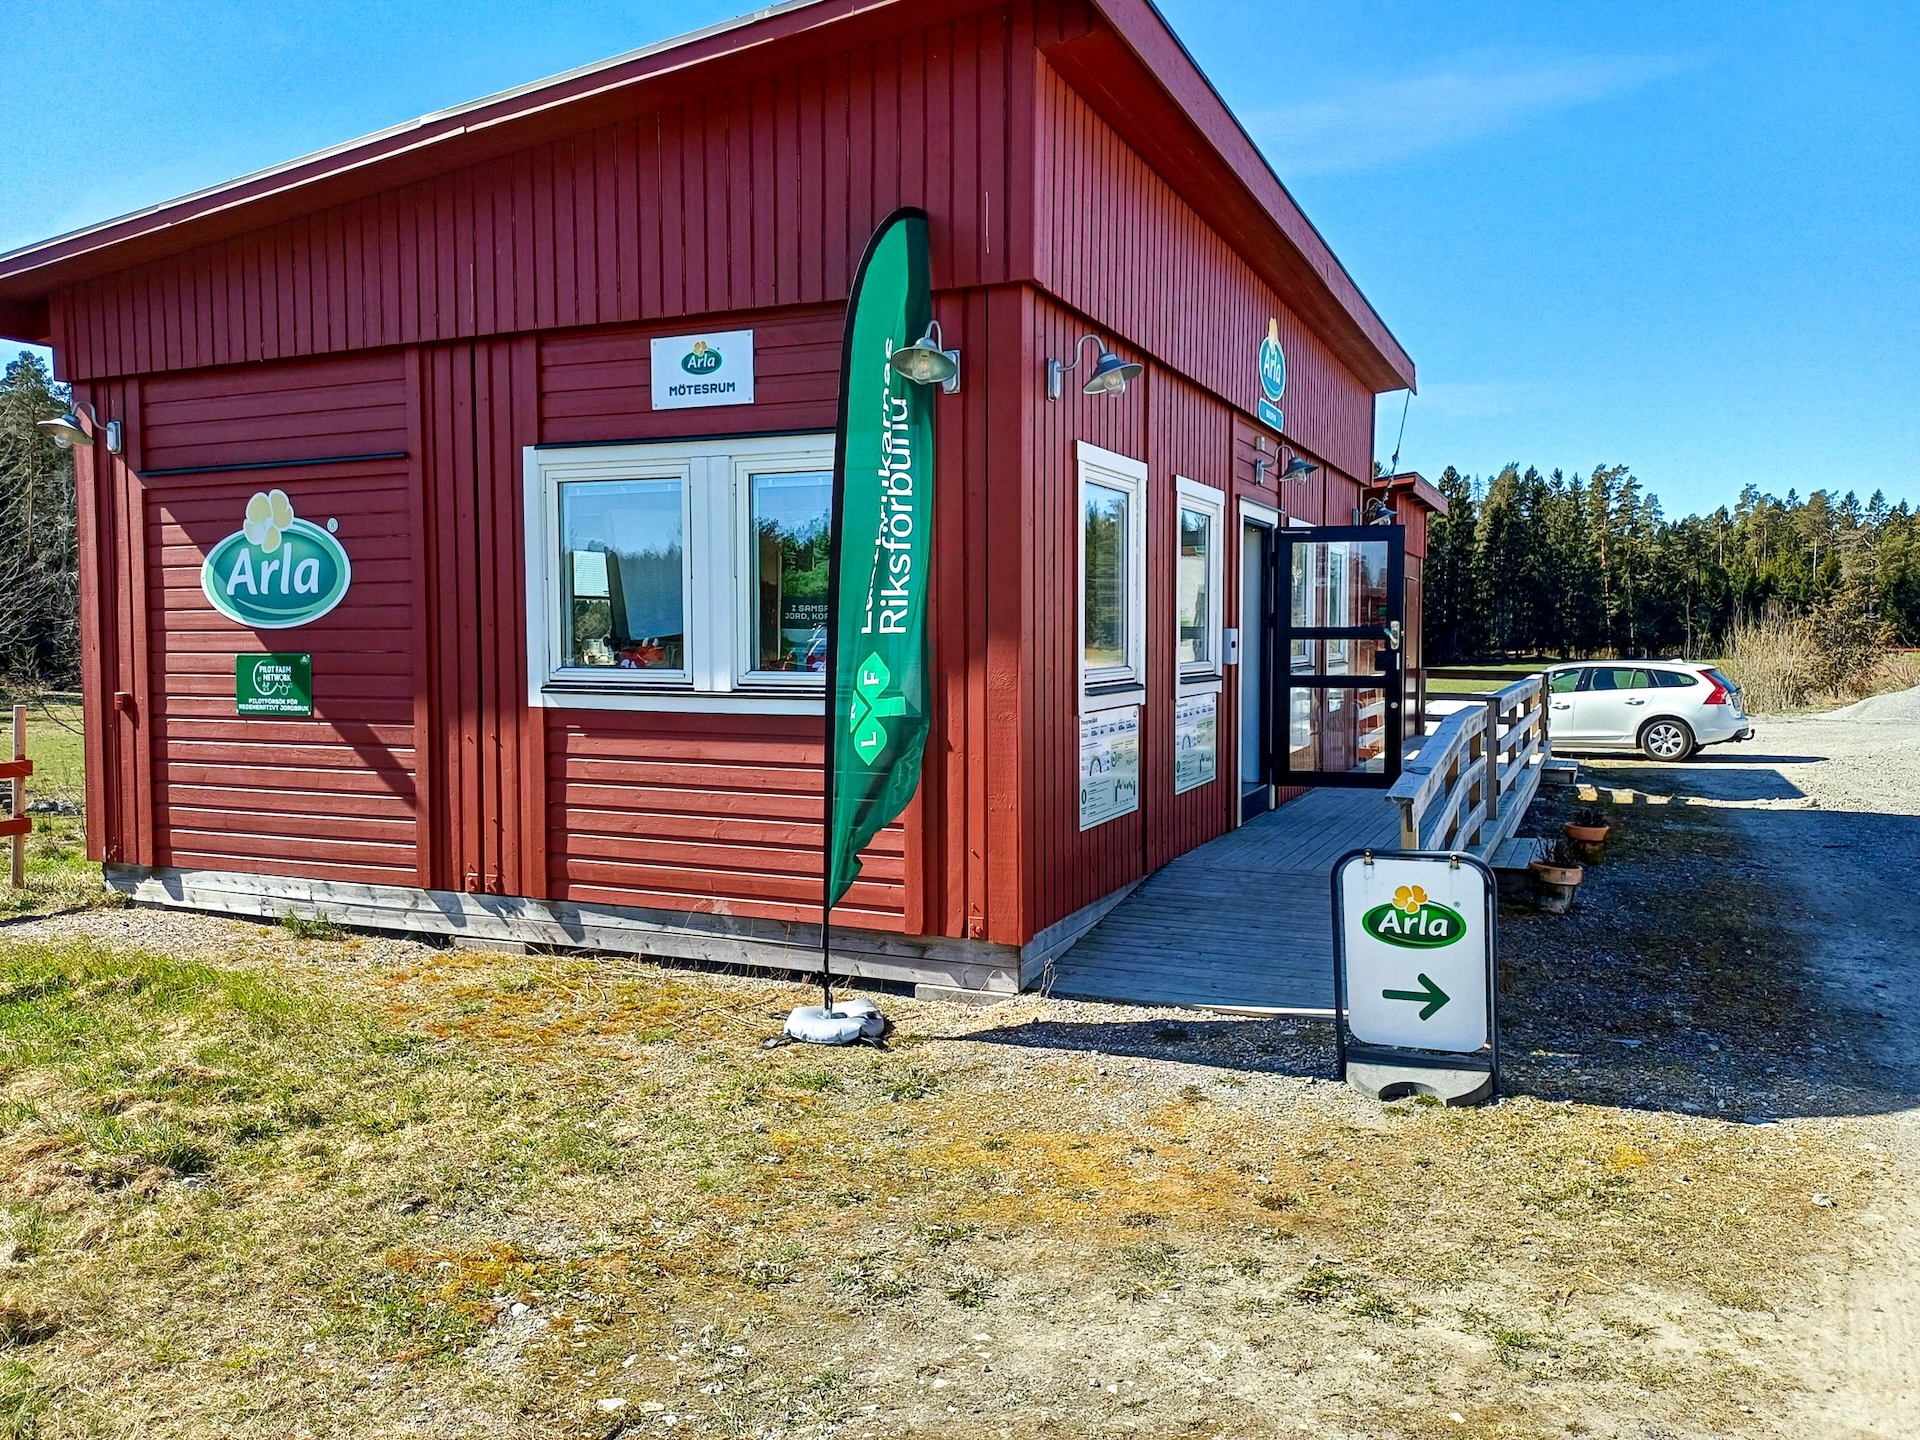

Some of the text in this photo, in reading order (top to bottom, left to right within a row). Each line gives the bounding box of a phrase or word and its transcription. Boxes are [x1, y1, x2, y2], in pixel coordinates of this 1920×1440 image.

[687, 353, 716, 369] Arla
[1263, 347, 1282, 386] Arla
[669, 382, 736, 396] MÖTESRUM
[227, 542, 320, 596] Arla
[784, 612, 810, 621] JORD,
[259, 665, 292, 674] PILOT FARM
[263, 673, 292, 682] NETWORK
[1377, 909, 1449, 938] Arla
